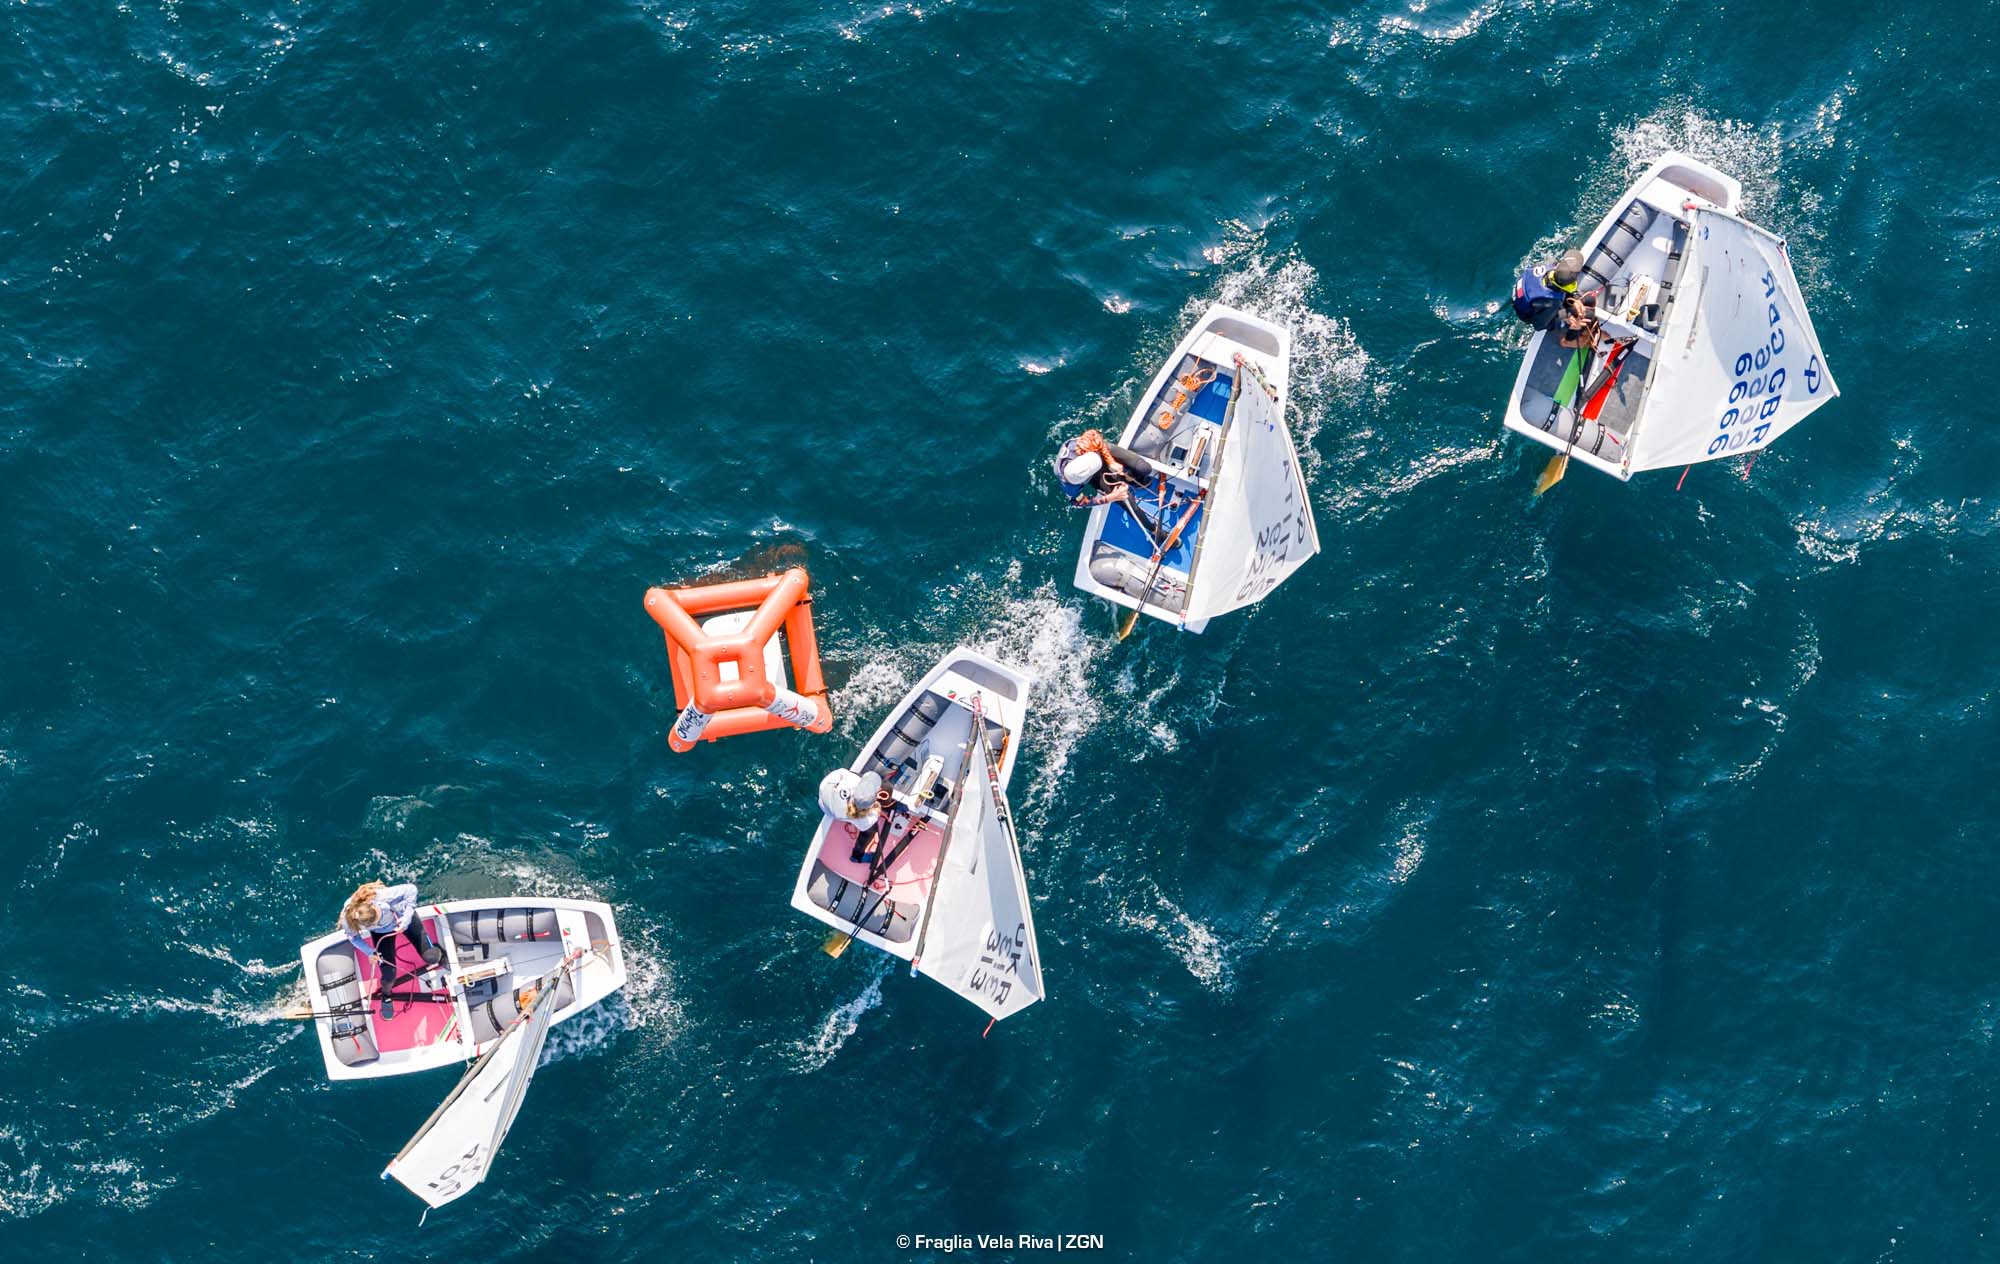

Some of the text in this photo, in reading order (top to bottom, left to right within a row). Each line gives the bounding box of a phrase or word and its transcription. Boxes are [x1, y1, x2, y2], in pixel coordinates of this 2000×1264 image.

[1707, 352, 1753, 456] 6666
[1747, 367, 1786, 445] GBR
[970, 929, 1001, 991] 313
[993, 923, 1025, 1006] UKR
